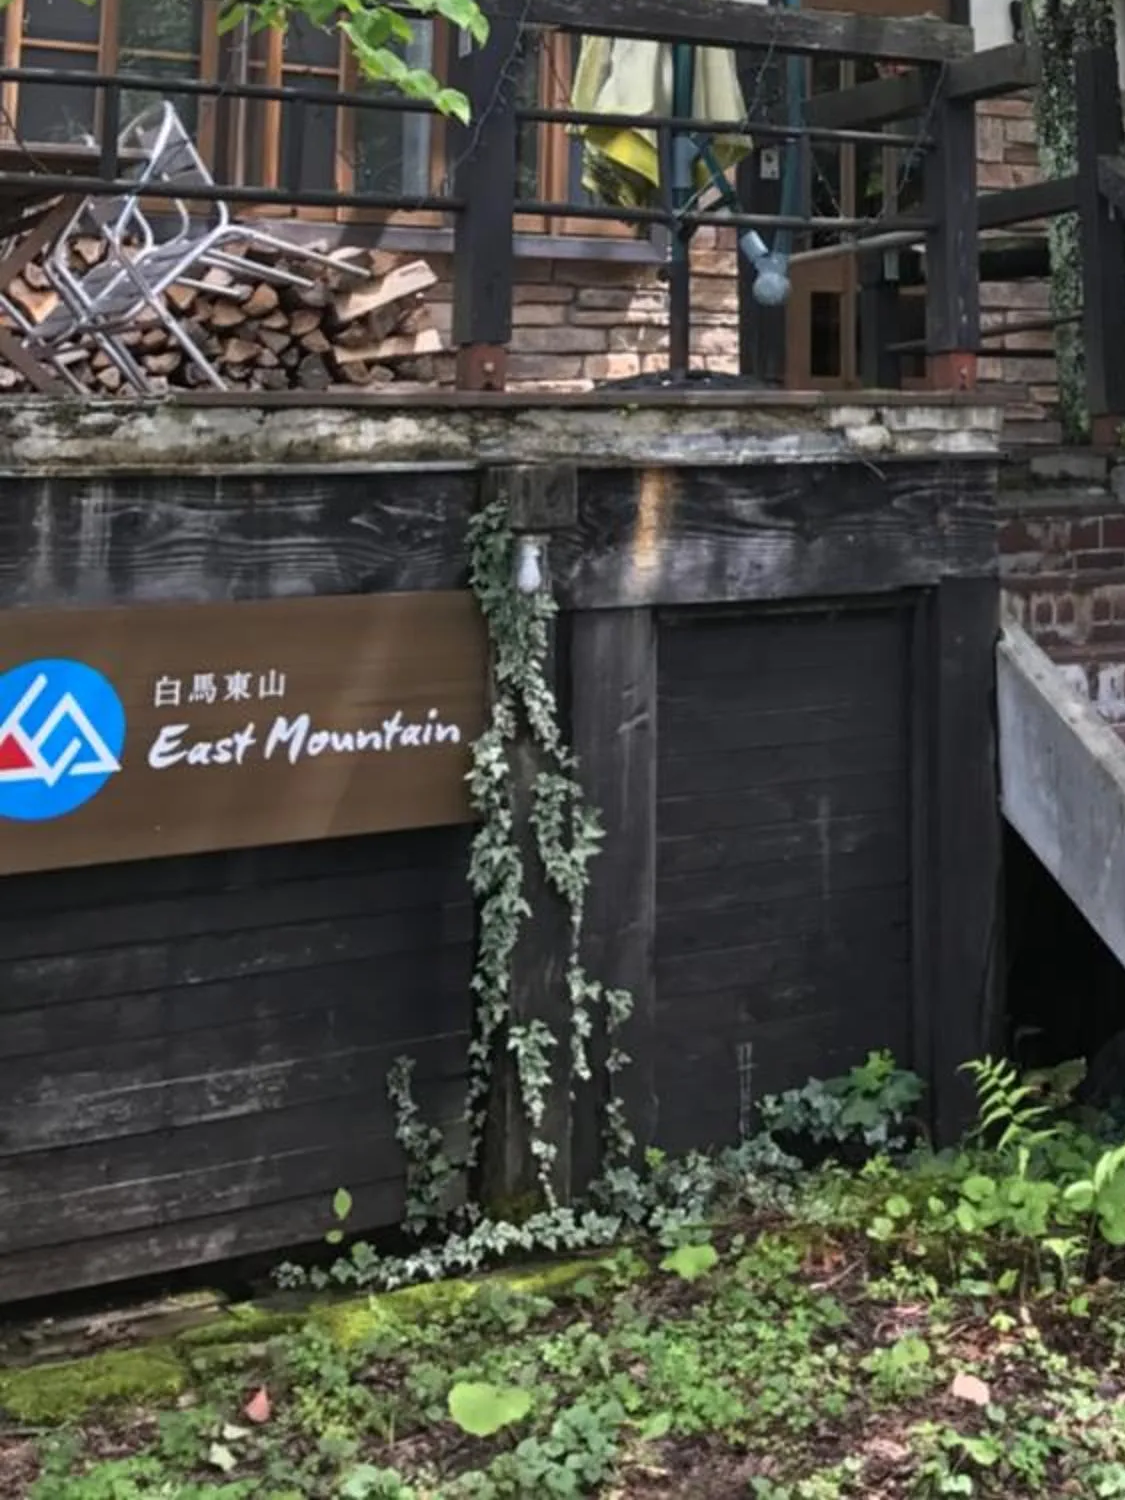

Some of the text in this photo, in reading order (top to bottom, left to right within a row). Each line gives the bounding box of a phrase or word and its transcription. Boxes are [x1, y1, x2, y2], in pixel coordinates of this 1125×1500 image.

[153, 669, 287, 708] 白馬東山
[148, 709, 461, 769] East Mountain
